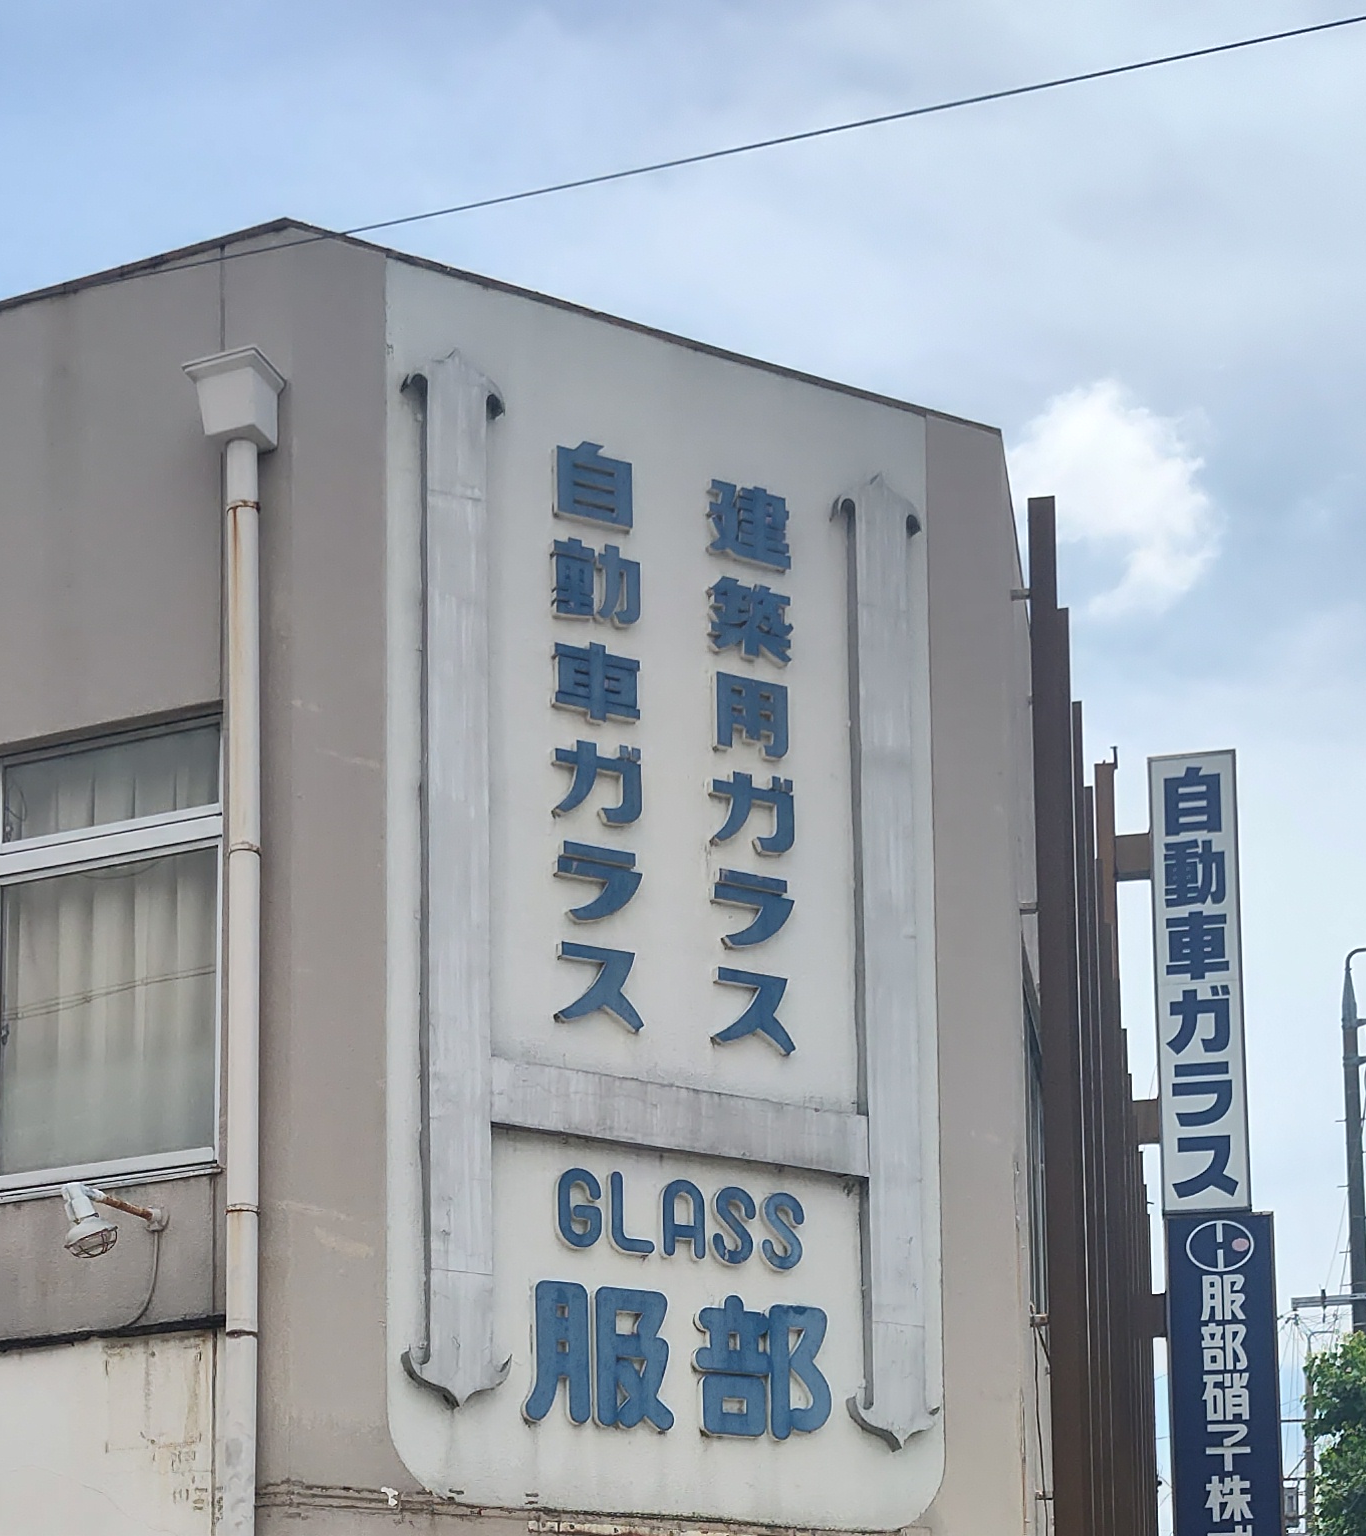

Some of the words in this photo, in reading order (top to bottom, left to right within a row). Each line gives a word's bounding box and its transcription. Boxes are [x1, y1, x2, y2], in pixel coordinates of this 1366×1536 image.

[550, 441, 644, 1034] 自動車ガラス
[705, 478, 797, 1057] 建築用ガラス
[1163, 766, 1239, 1199] 自動車ガラス
[522, 1280, 831, 1441] 服部
[556, 1166, 805, 1273] GLASS
